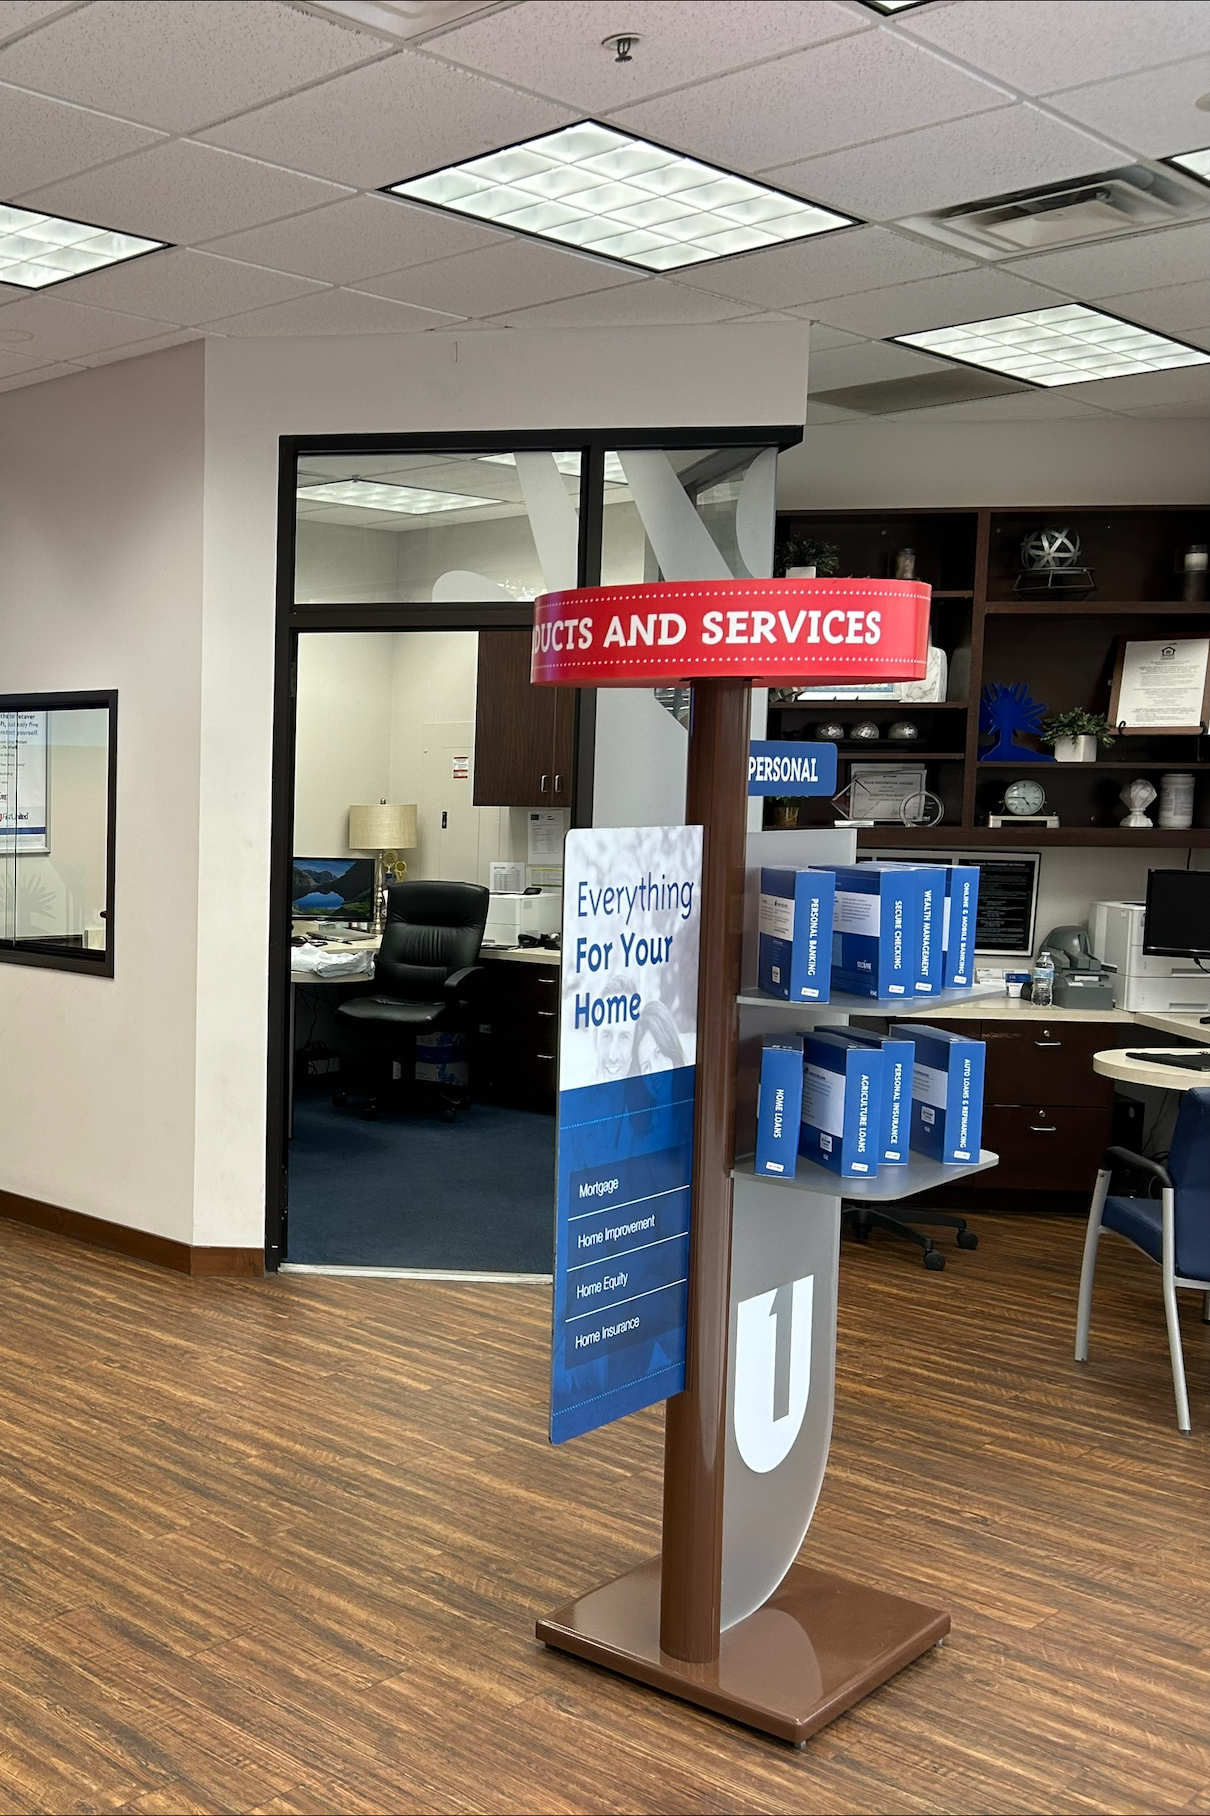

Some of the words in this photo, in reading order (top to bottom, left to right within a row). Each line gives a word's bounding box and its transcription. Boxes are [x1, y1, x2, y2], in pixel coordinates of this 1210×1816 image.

[603, 613, 687, 648] AND
[702, 610, 881, 645] SERVICES
[748, 756, 819, 782] PERSONAL
[578, 871, 694, 926] Everything
[894, 900, 903, 930] SECURE
[923, 889, 932, 921] WEALTH
[809, 898, 819, 938] PERSONAL
[960, 916, 968, 942] MOBILE
[576, 937, 613, 974] For
[620, 932, 673, 968] Your
[807, 939, 818, 976] BANKING
[893, 931, 902, 970] CHECKING
[921, 922, 931, 976] MANAGEMENT
[958, 943, 966, 974] BANKING
[575, 992, 642, 1030] Home
[893, 1063, 902, 1101] PERSONAL
[963, 1058, 971, 1077] AUTO
[775, 1088, 784, 1111] HOME
[859, 1074, 869, 1126] AGRICULTURE
[962, 1078, 970, 1099] LOANS
[773, 1112, 783, 1139] LOANS
[857, 1127, 867, 1153] LOANS
[890, 1102, 900, 1144] INSURANCE
[959, 1106, 968, 1148] REFINANCING
[579, 1177, 619, 1199] Mortgage
[578, 1230, 604, 1249] Home
[605, 1214, 656, 1243] Improvement
[576, 1279, 602, 1299] Home
[603, 1272, 629, 1292] Equity
[575, 1331, 601, 1349] Home
[601, 1315, 640, 1336] Insurance
